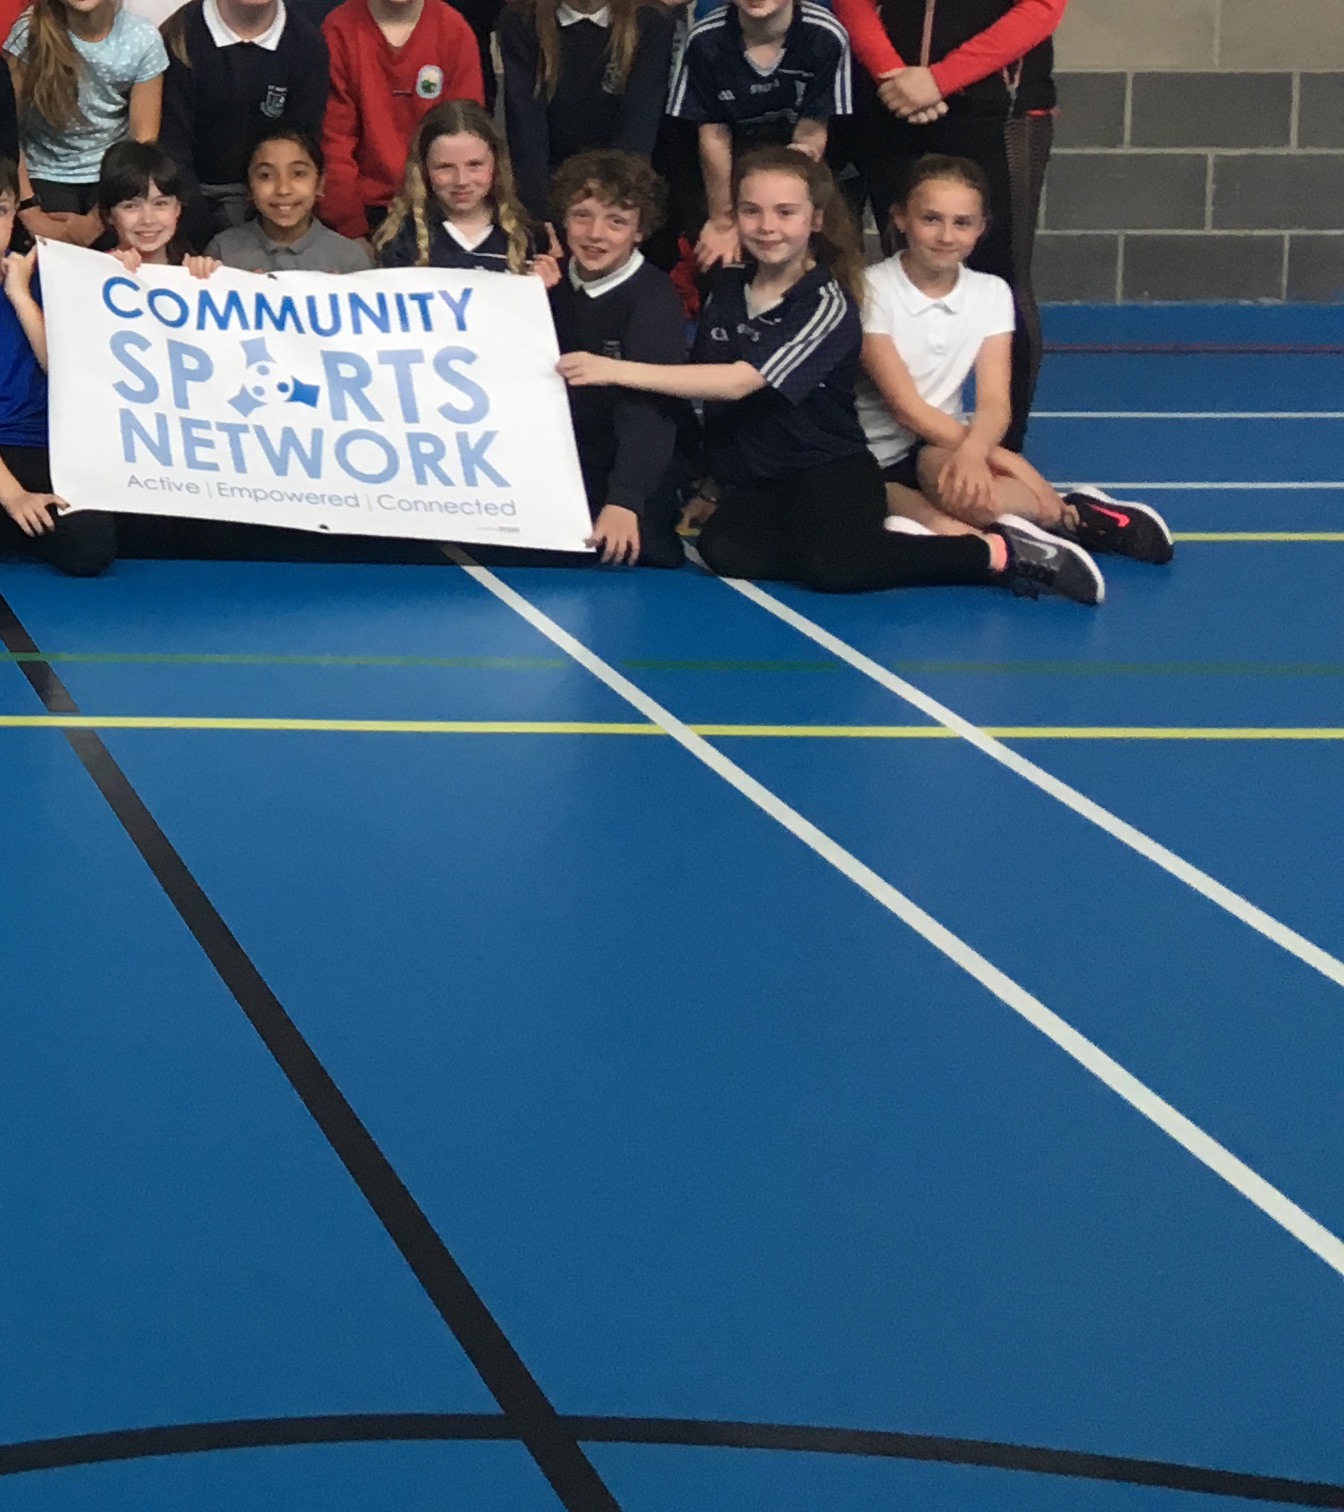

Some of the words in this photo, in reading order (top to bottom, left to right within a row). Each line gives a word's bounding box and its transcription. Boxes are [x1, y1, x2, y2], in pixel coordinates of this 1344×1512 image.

[102, 276, 473, 337] COMMUNITY
[119, 408, 512, 487] NETWORK
[126, 473, 200, 495] Active
[217, 481, 360, 509] Empowered
[377, 493, 517, 516] Connected
